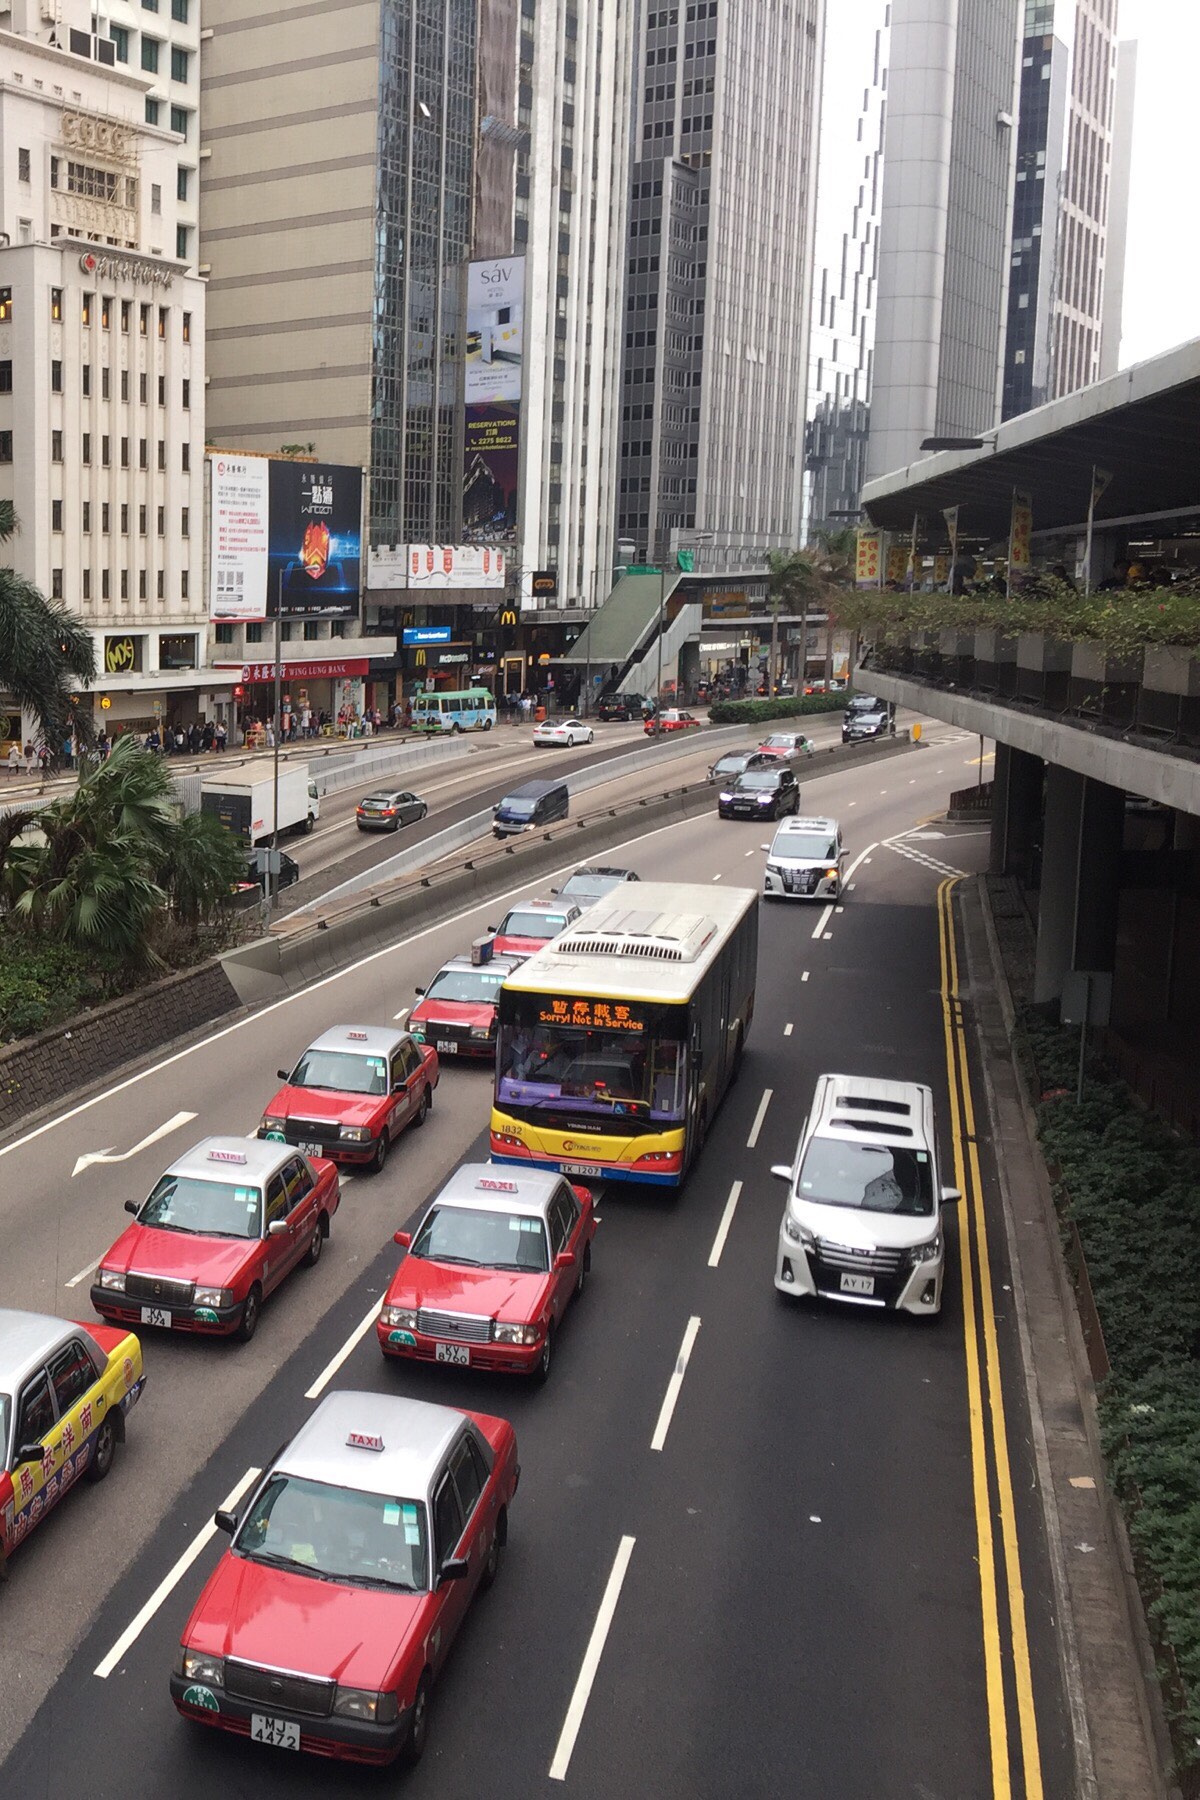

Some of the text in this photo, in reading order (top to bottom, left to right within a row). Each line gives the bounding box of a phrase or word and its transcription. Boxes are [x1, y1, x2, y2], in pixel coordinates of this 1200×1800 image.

[481, 263, 512, 284] sáv
[468, 420, 516, 428] RESERVATIONS
[289, 667, 307, 676] WING
[308, 666, 328, 675] LUNG
[328, 664, 346, 674] BANK
[540, 1011, 570, 1024] Sorry!
[572, 1014, 592, 1025] Not
[606, 1019, 644, 1030] Service
[502, 1124, 523, 1135] 1832
[210, 1151, 230, 1160] TAXI
[578, 1166, 599, 1175] 1207
[480, 1179, 514, 1190] TAXI
[843, 1280, 873, 1290] AY 17
[150, 1308, 163, 1318] KA
[350, 1433, 379, 1448] TAXI
[266, 1718, 286, 1733] MJ
[255, 1728, 296, 1748] 4472
